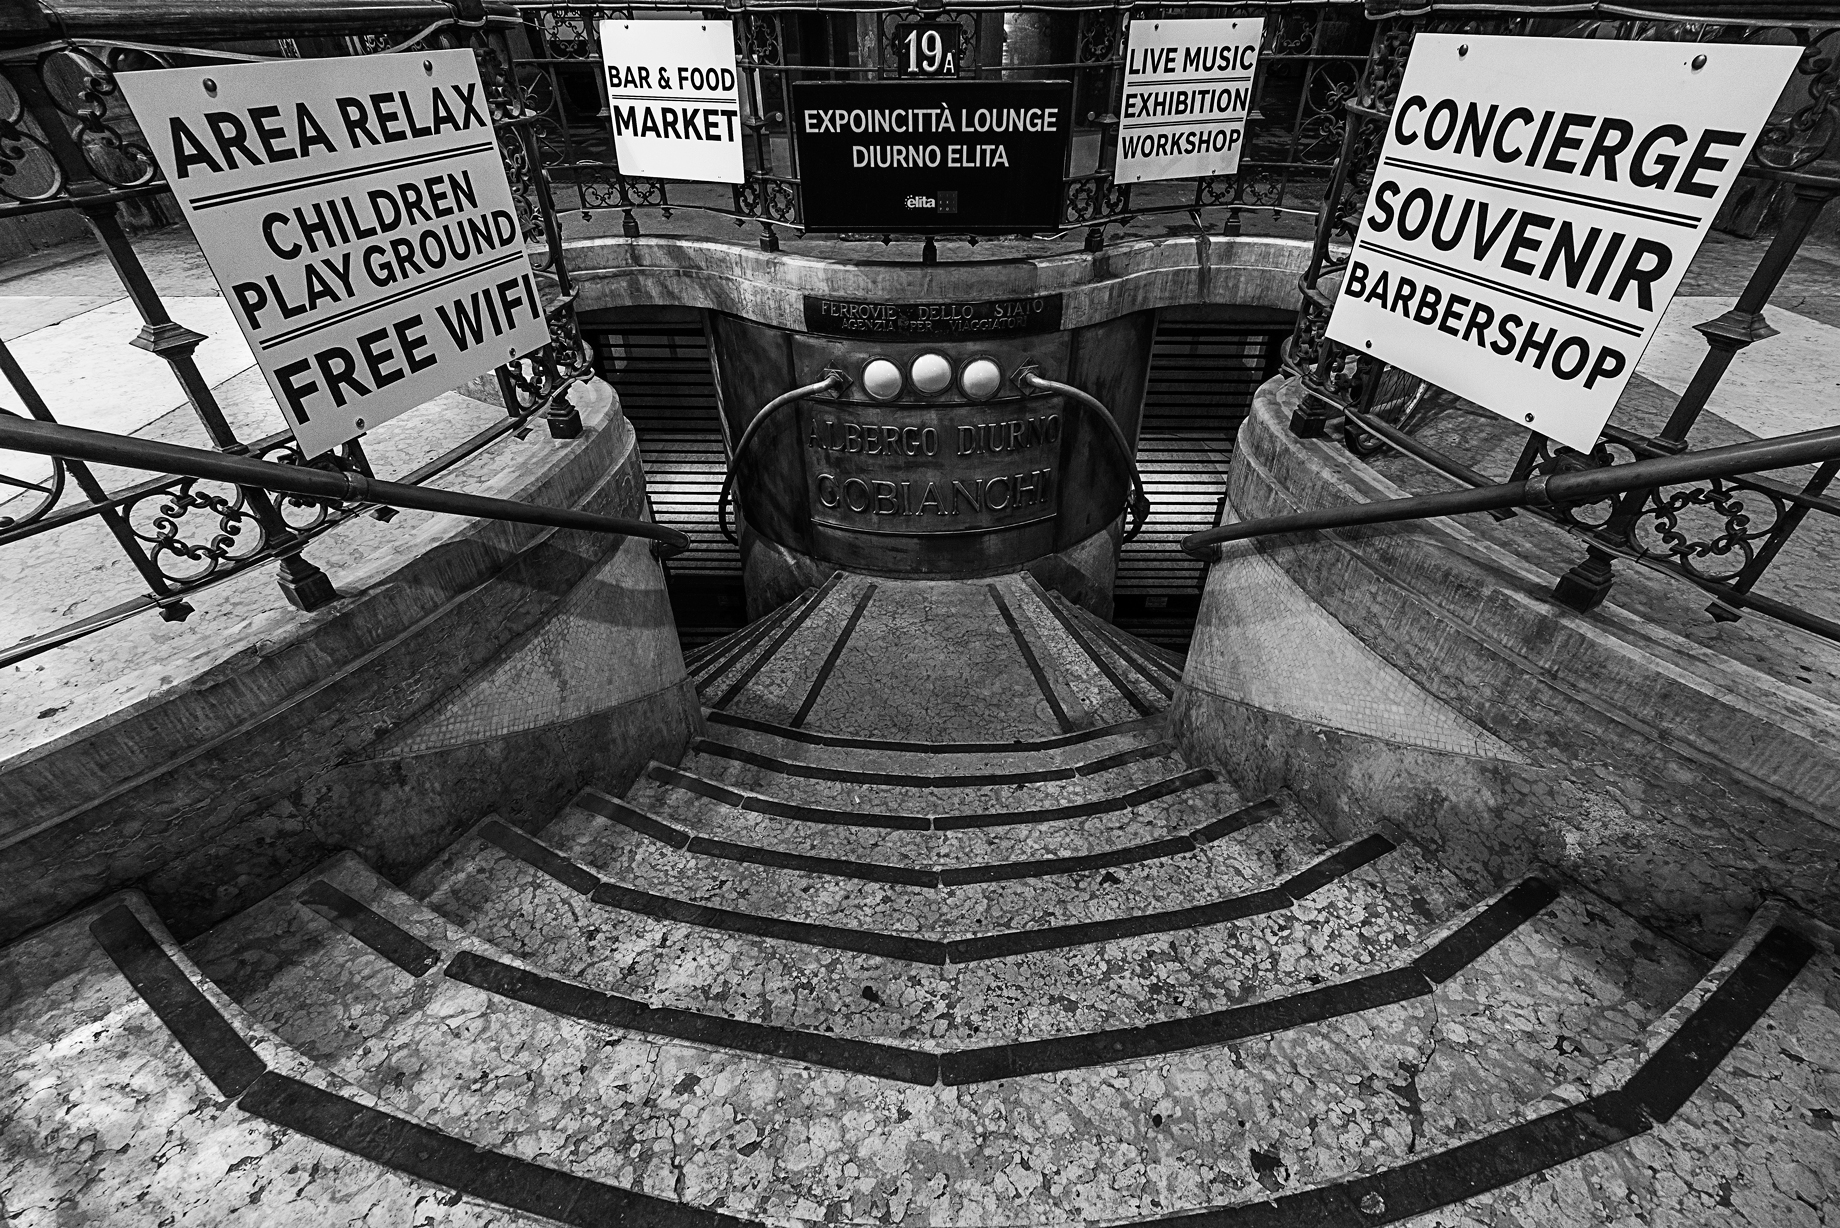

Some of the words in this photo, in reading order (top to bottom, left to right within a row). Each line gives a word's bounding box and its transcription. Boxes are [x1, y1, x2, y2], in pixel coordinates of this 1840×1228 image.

[904, 29, 954, 73] 19A
[1128, 47, 1178, 75] LIVE
[1182, 45, 1256, 72] MUSIC
[608, 65, 652, 89] BAR
[658, 66, 672, 90] &
[678, 67, 735, 91] FOOD
[804, 102, 955, 133] EXPOINCITTÀ
[961, 108, 1058, 132] LOUNGE
[1124, 88, 1249, 118] EXHIBITION
[168, 102, 336, 180] AREA
[335, 83, 487, 149] RELAX
[613, 105, 738, 142] MARKET
[852, 145, 941, 168] DIURNO
[947, 145, 1009, 167] ELITA
[1122, 129, 1241, 159] WORKSHOP
[1393, 95, 1746, 199] CONCIERGE
[262, 170, 479, 260] CHILDREN
[906, 196, 936, 209] elita
[1367, 181, 1673, 312] SOUVENIR
[821, 300, 897, 320] FERROVIE
[918, 305, 973, 320] DELLO
[994, 299, 1043, 317] STATO
[841, 318, 895, 331] AGENZIA
[909, 320, 933, 332] PER
[950, 315, 1027, 332] VIAGGIATORI
[1343, 260, 1626, 391] BARBERSHOP
[273, 314, 438, 425] FREE
[435, 273, 540, 352] WIFI
[808, 418, 939, 456] ALBERGO
[957, 414, 1059, 455] DIURNO
[816, 468, 1051, 516] GOBIANCHI
